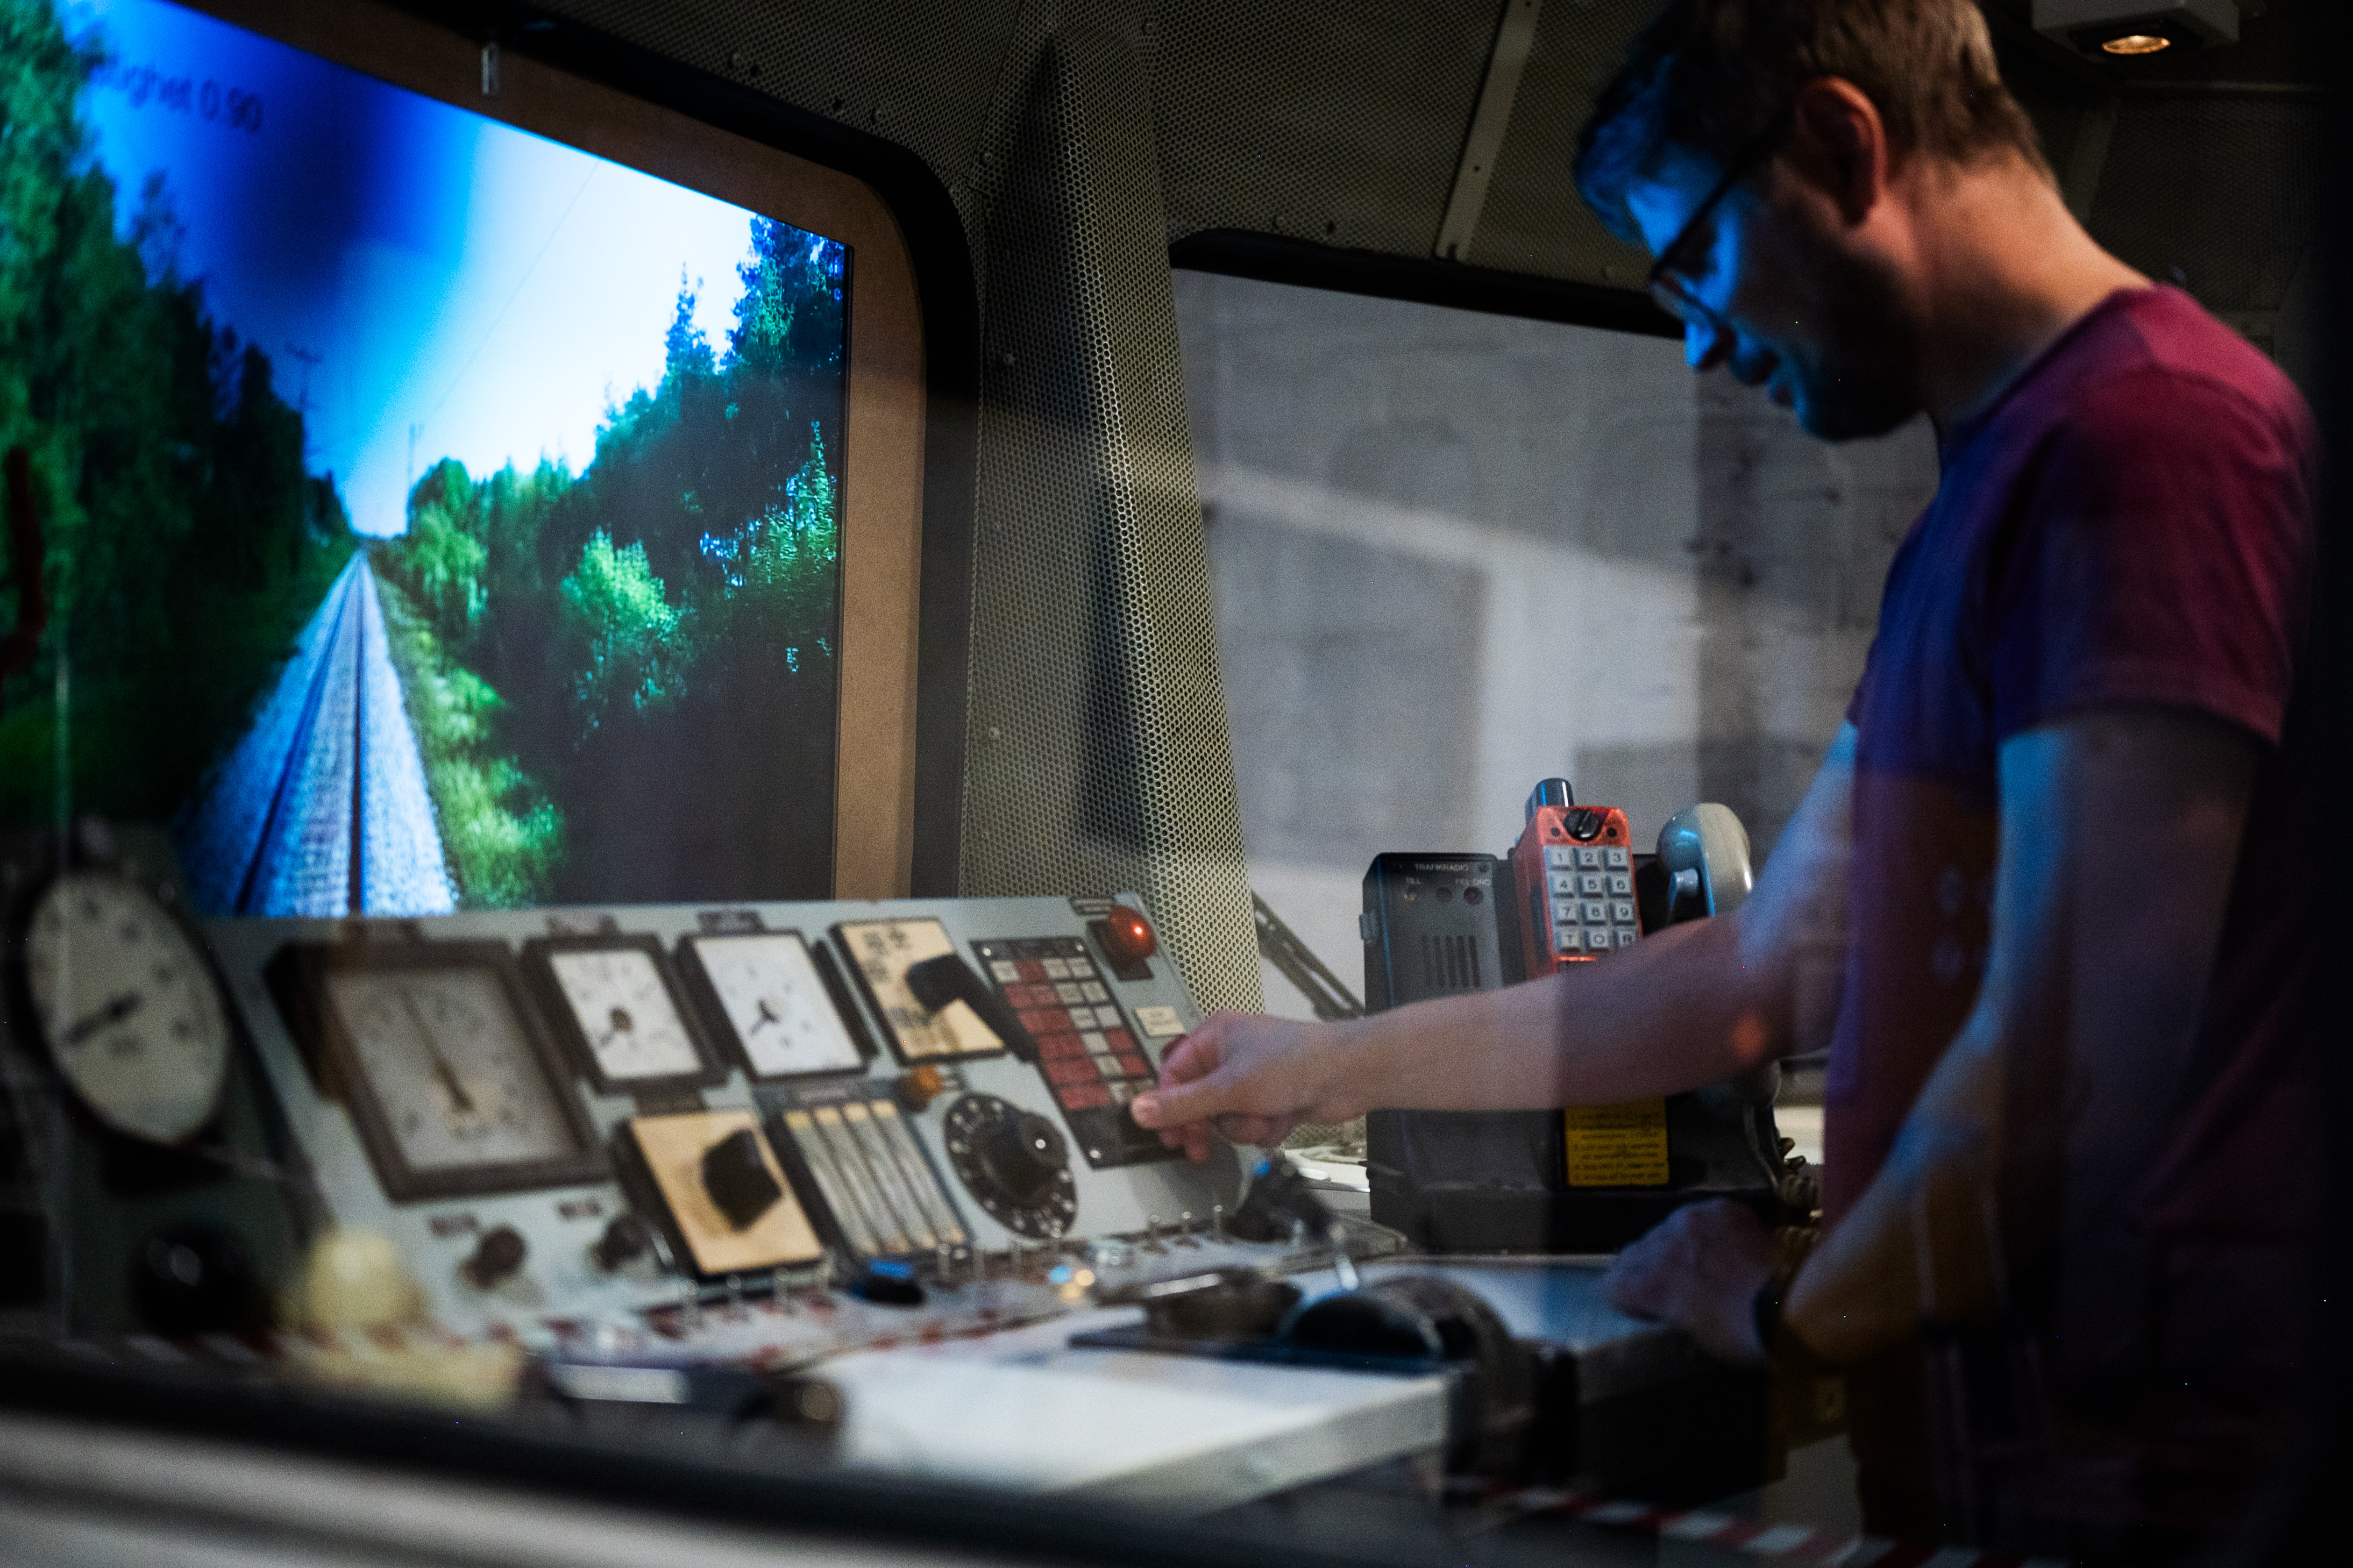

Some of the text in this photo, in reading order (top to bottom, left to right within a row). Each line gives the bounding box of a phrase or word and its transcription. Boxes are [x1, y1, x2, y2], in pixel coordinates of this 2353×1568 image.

[1558, 852, 1622, 863] 1 2 3
[1414, 863, 1469, 872] TRAFIKRADIO
[1560, 880, 1625, 890] 4 5 6
[1562, 907, 1629, 917] 7 8 9
[1565, 933, 1574, 944] T
[1623, 933, 1633, 943] R
